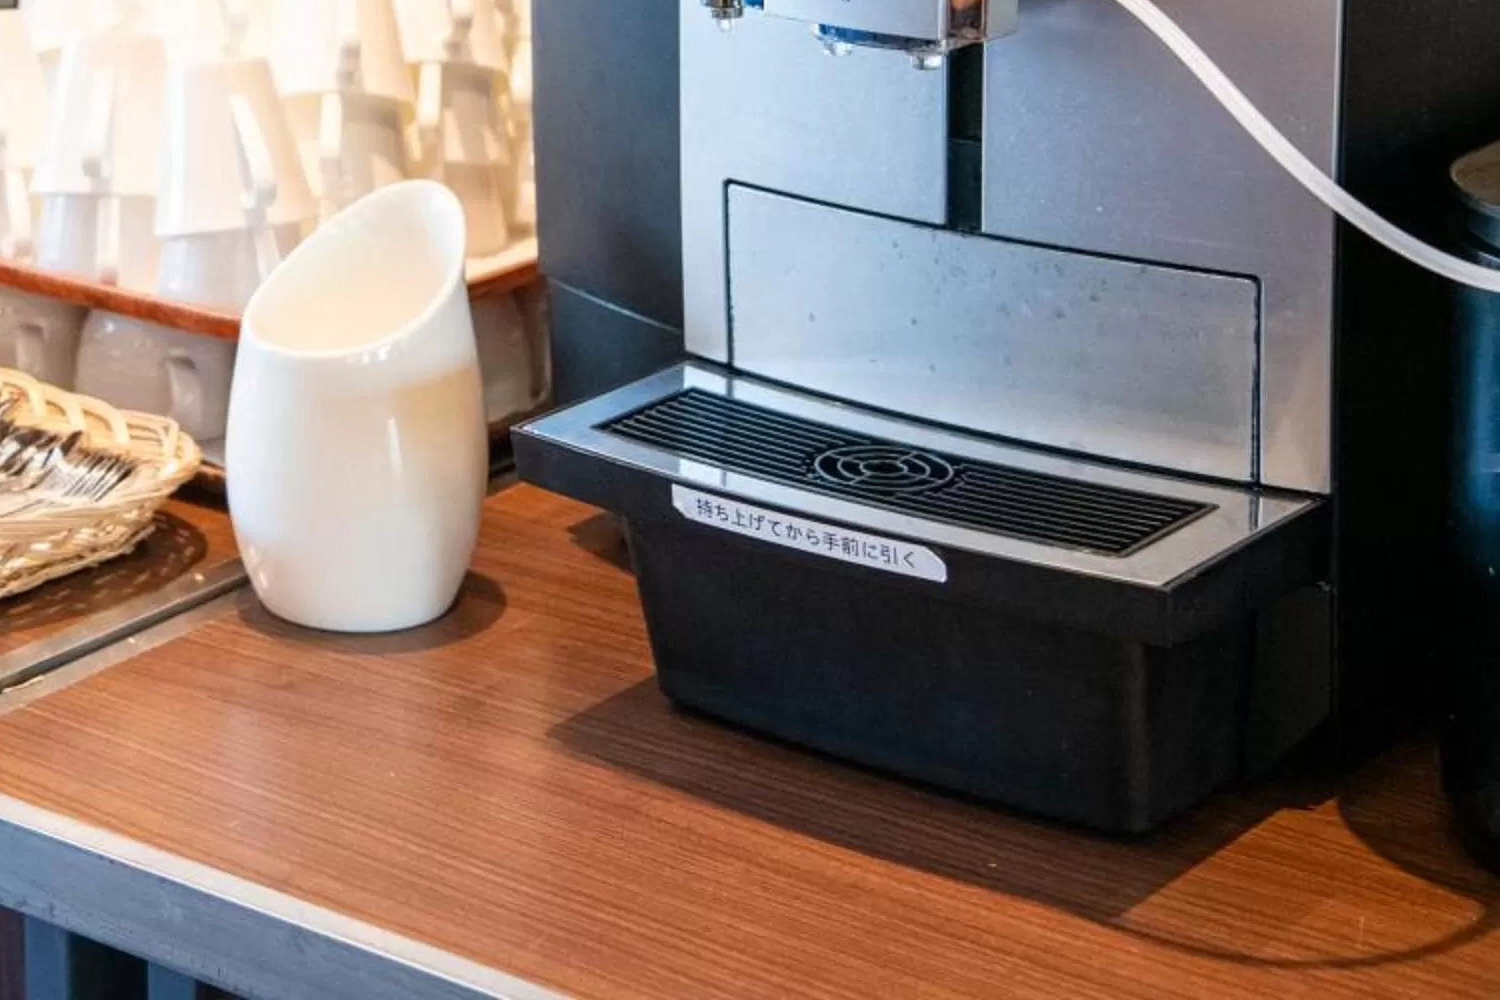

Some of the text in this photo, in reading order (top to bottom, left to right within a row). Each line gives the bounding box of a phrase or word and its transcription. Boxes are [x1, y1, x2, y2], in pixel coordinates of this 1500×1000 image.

[695, 497, 917, 569] 持ち上げてから手前に引く
